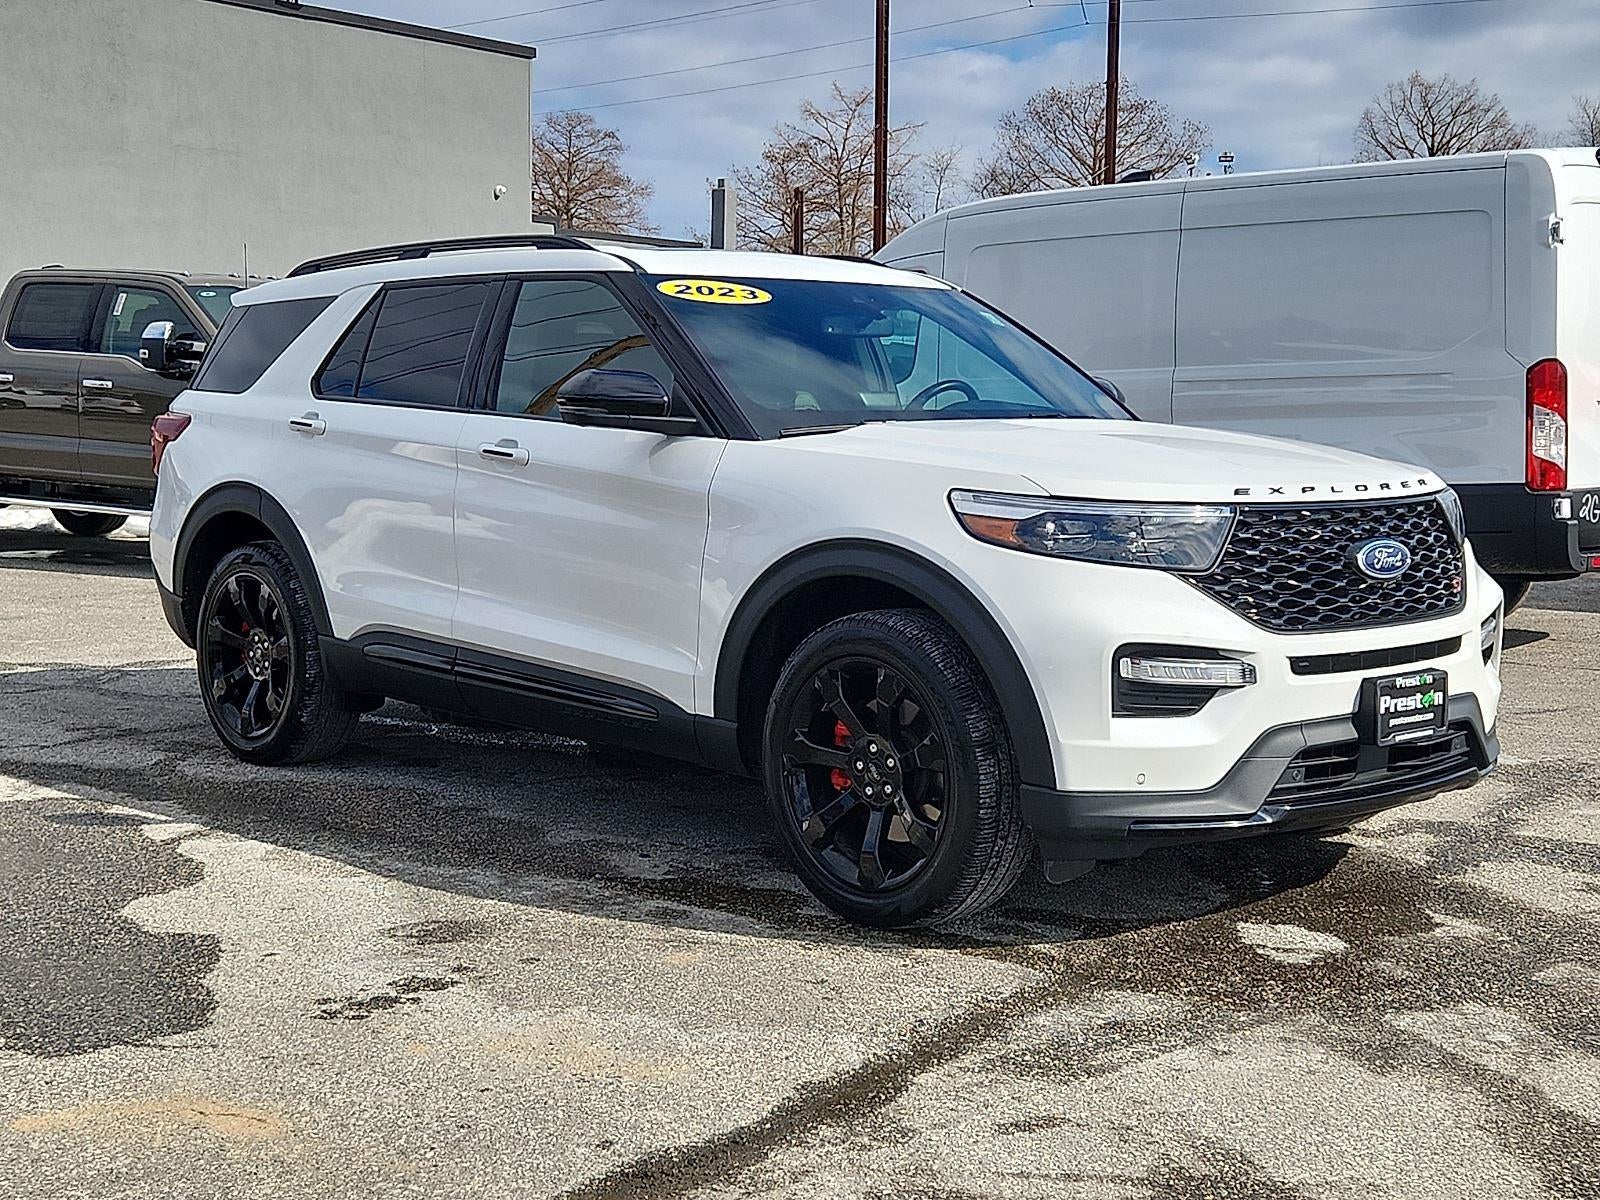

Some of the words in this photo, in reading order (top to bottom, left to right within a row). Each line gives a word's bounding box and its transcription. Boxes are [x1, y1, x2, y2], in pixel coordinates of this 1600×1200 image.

[673, 284, 760, 300] 2023
[1233, 478, 1428, 496] EXPLORER
[1373, 547, 1403, 569] Ford
[1395, 674, 1433, 689] Preston
[1379, 688, 1444, 715] Preston
